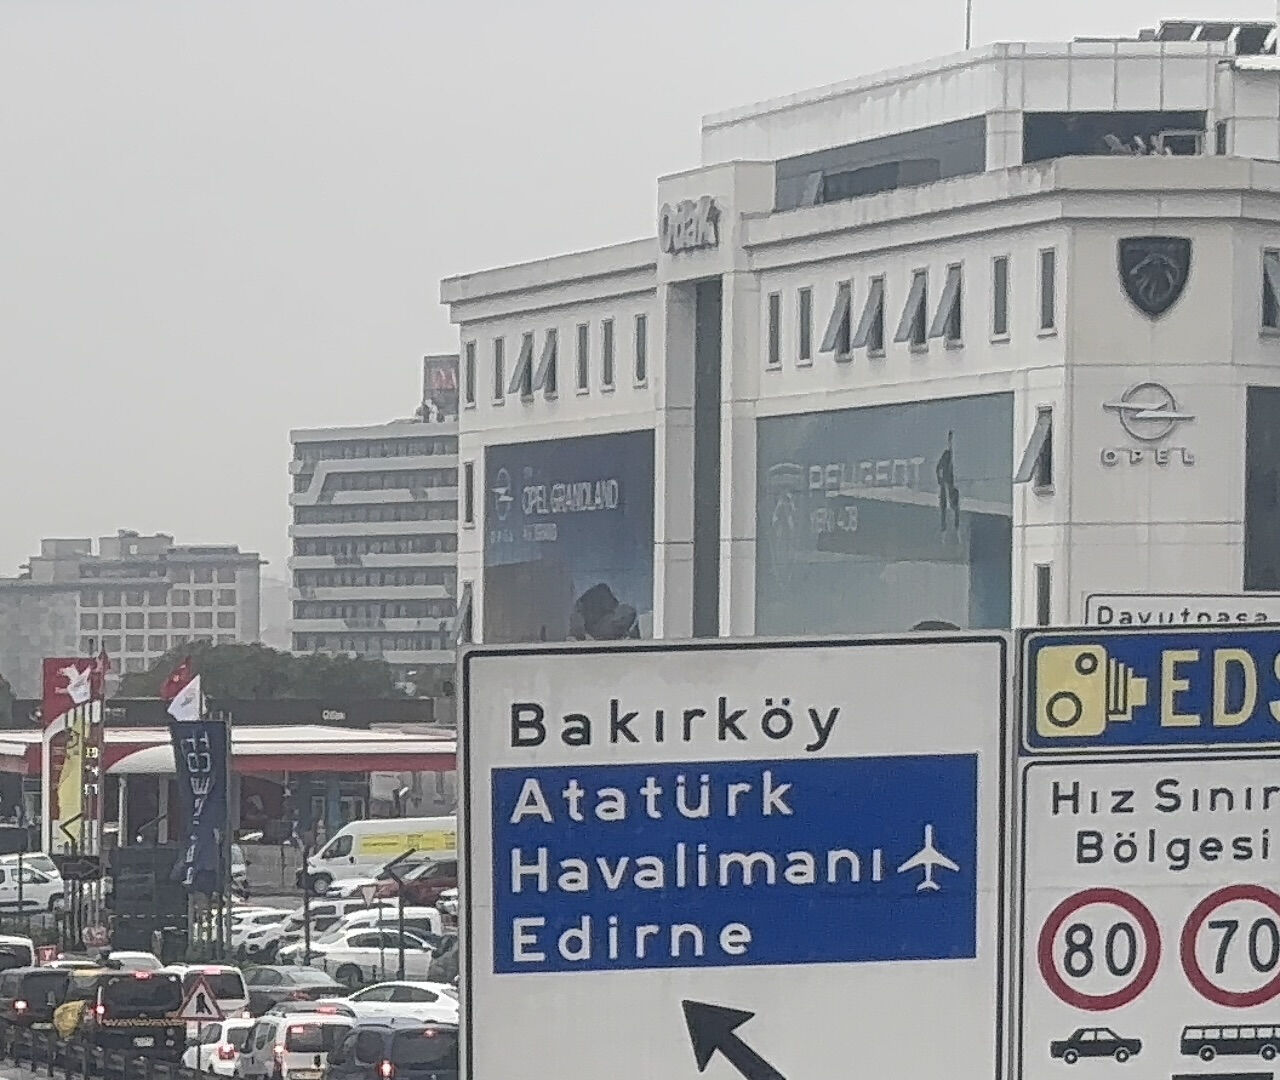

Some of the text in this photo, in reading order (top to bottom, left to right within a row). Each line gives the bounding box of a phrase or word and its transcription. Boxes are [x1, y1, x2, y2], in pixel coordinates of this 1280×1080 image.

[1100, 447, 1196, 468] OPEL
[1160, 647, 1280, 728] ED
[510, 697, 842, 751] Bakırköy
[510, 770, 794, 825] Atatürk
[1052, 781, 1135, 816] Hız
[510, 841, 885, 895] Havalimanı
[1076, 828, 1271, 871] Bölgesi
[511, 915, 754, 965] Edirne
[1063, 921, 1138, 979] 80
[1207, 916, 1280, 975] 70
